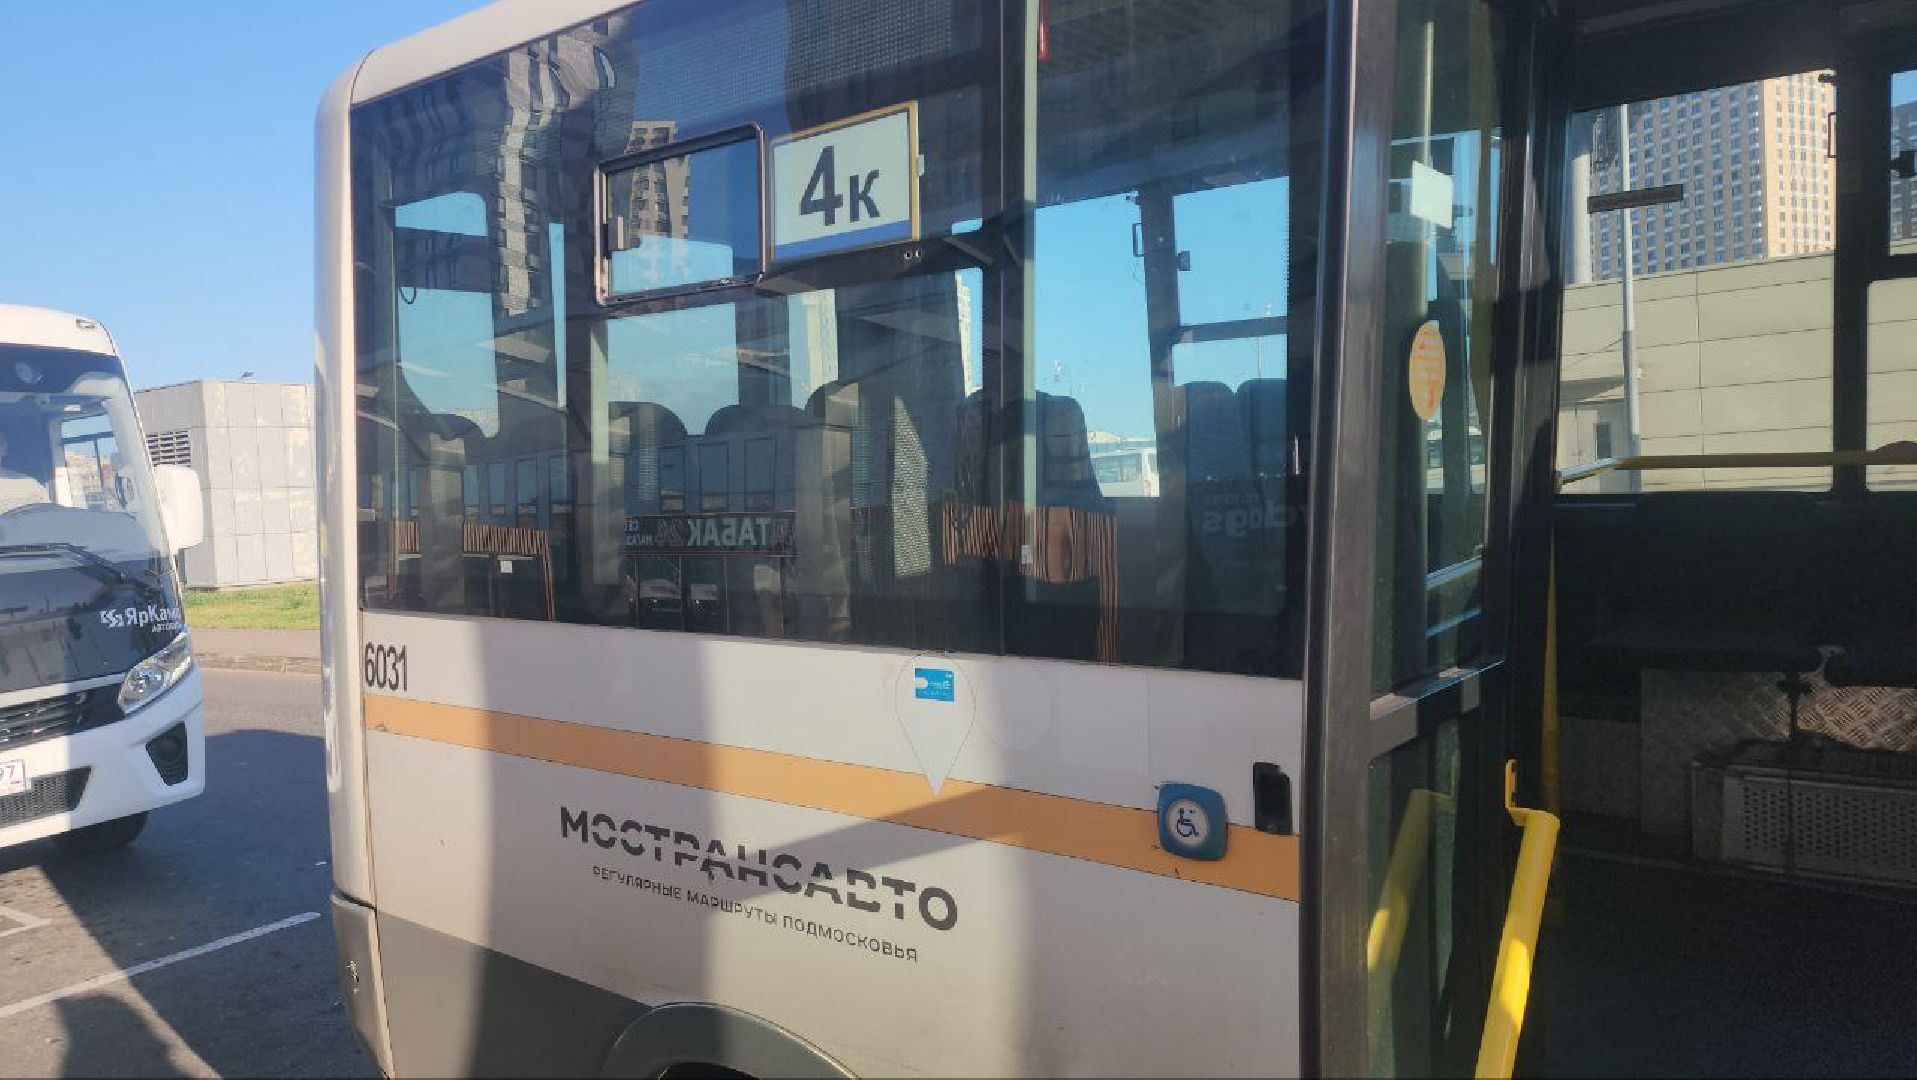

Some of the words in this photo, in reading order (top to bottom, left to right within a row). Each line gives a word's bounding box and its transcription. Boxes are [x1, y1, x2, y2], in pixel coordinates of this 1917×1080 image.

[365, 641, 408, 692] 6031
[560, 806, 958, 931] МОСТРАНСАВТО
[592, 865, 682, 899] РЕГУЛЯРНЫЕ
[687, 890, 778, 925] МАРШРУТЫ
[783, 915, 918, 962] ПОДМОСКОВЬЯ
